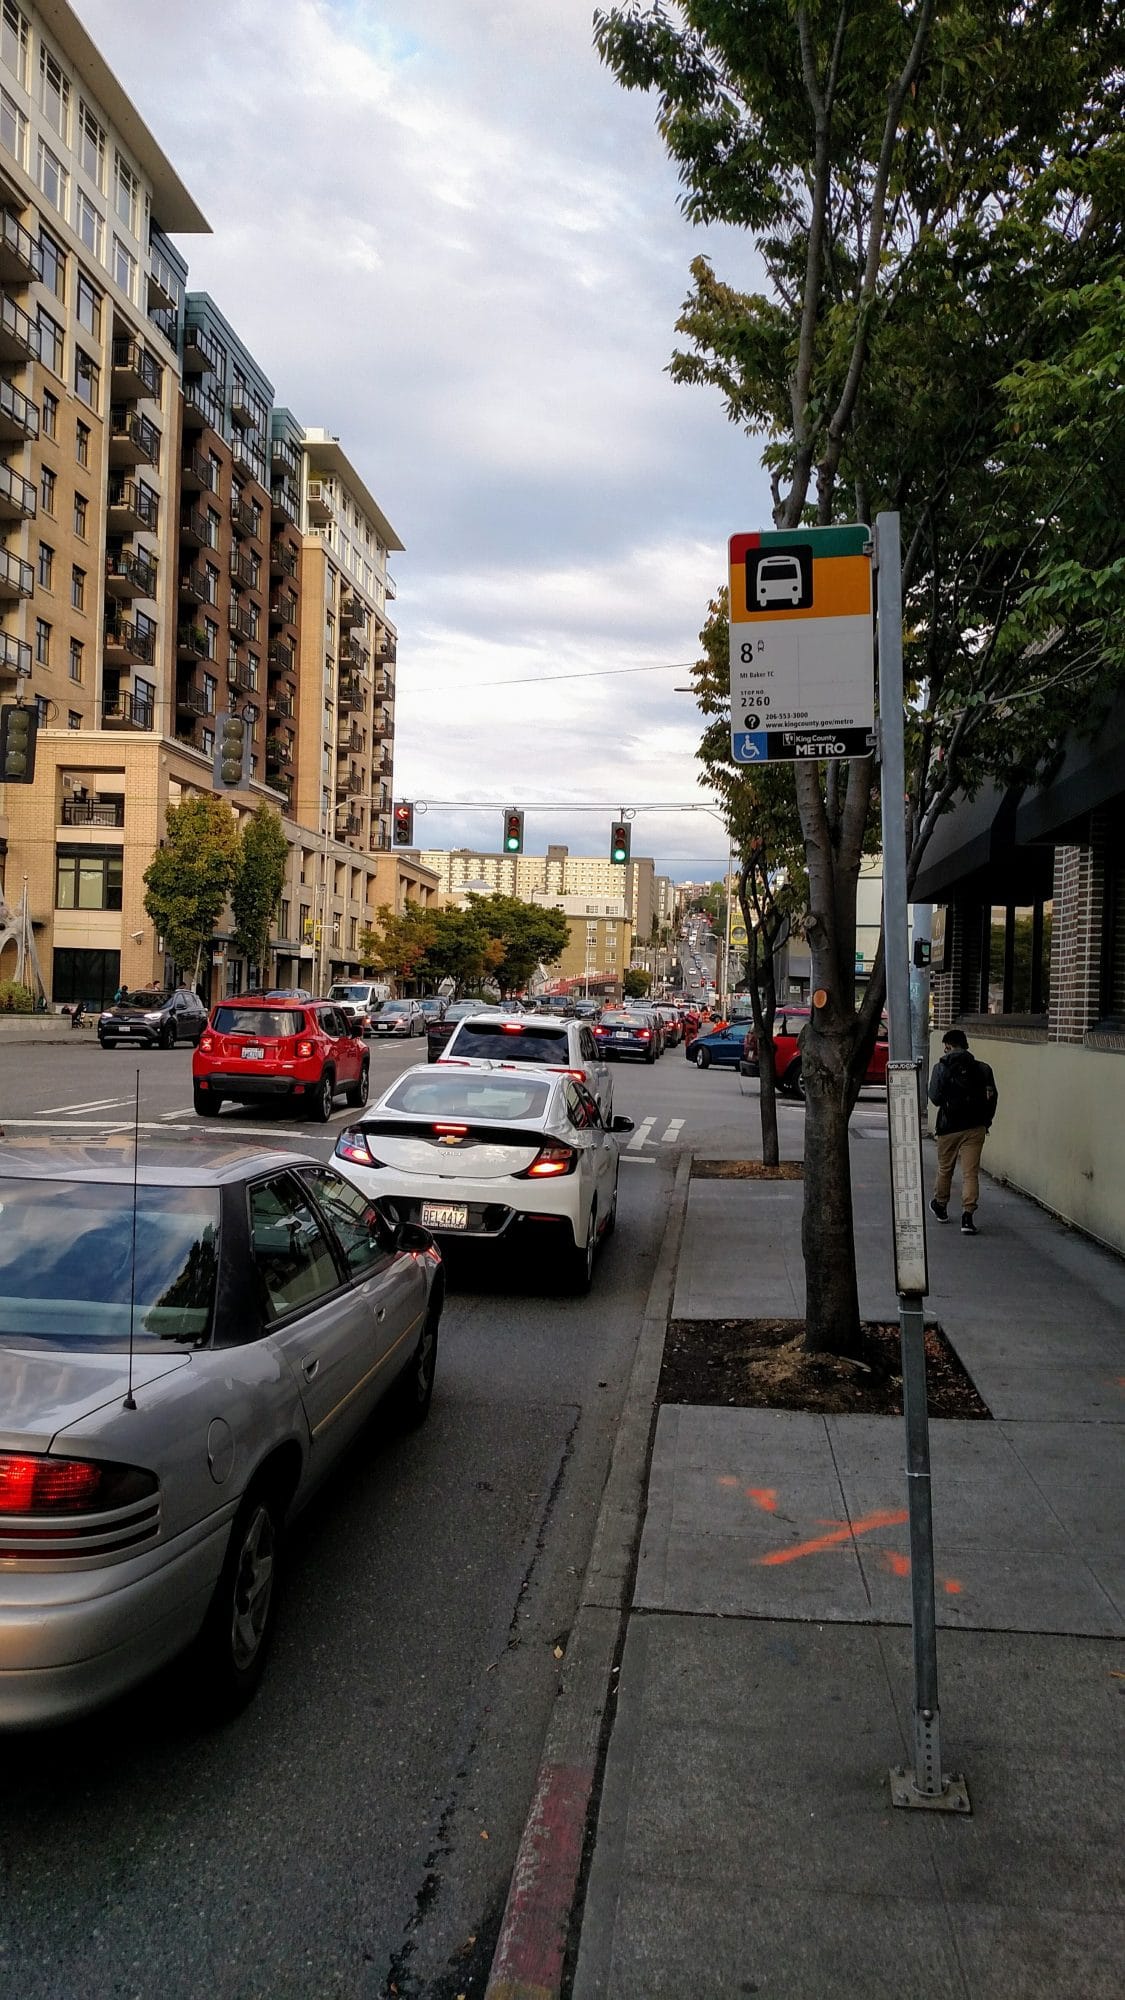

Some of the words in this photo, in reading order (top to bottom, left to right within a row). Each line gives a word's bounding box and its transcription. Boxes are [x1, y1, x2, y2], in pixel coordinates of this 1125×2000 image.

[740, 642, 753, 664] 8
[749, 671, 766, 679] Baker
[741, 696, 770, 707] 2260
[765, 712, 808, 720] 206-553-3000
[766, 718, 854, 728] www.kingcounty.gov/metro
[795, 735, 812, 743] King
[811, 734, 836, 742] County
[795, 743, 846, 756] METRO
[424, 1210, 464, 1224] BEL4412
